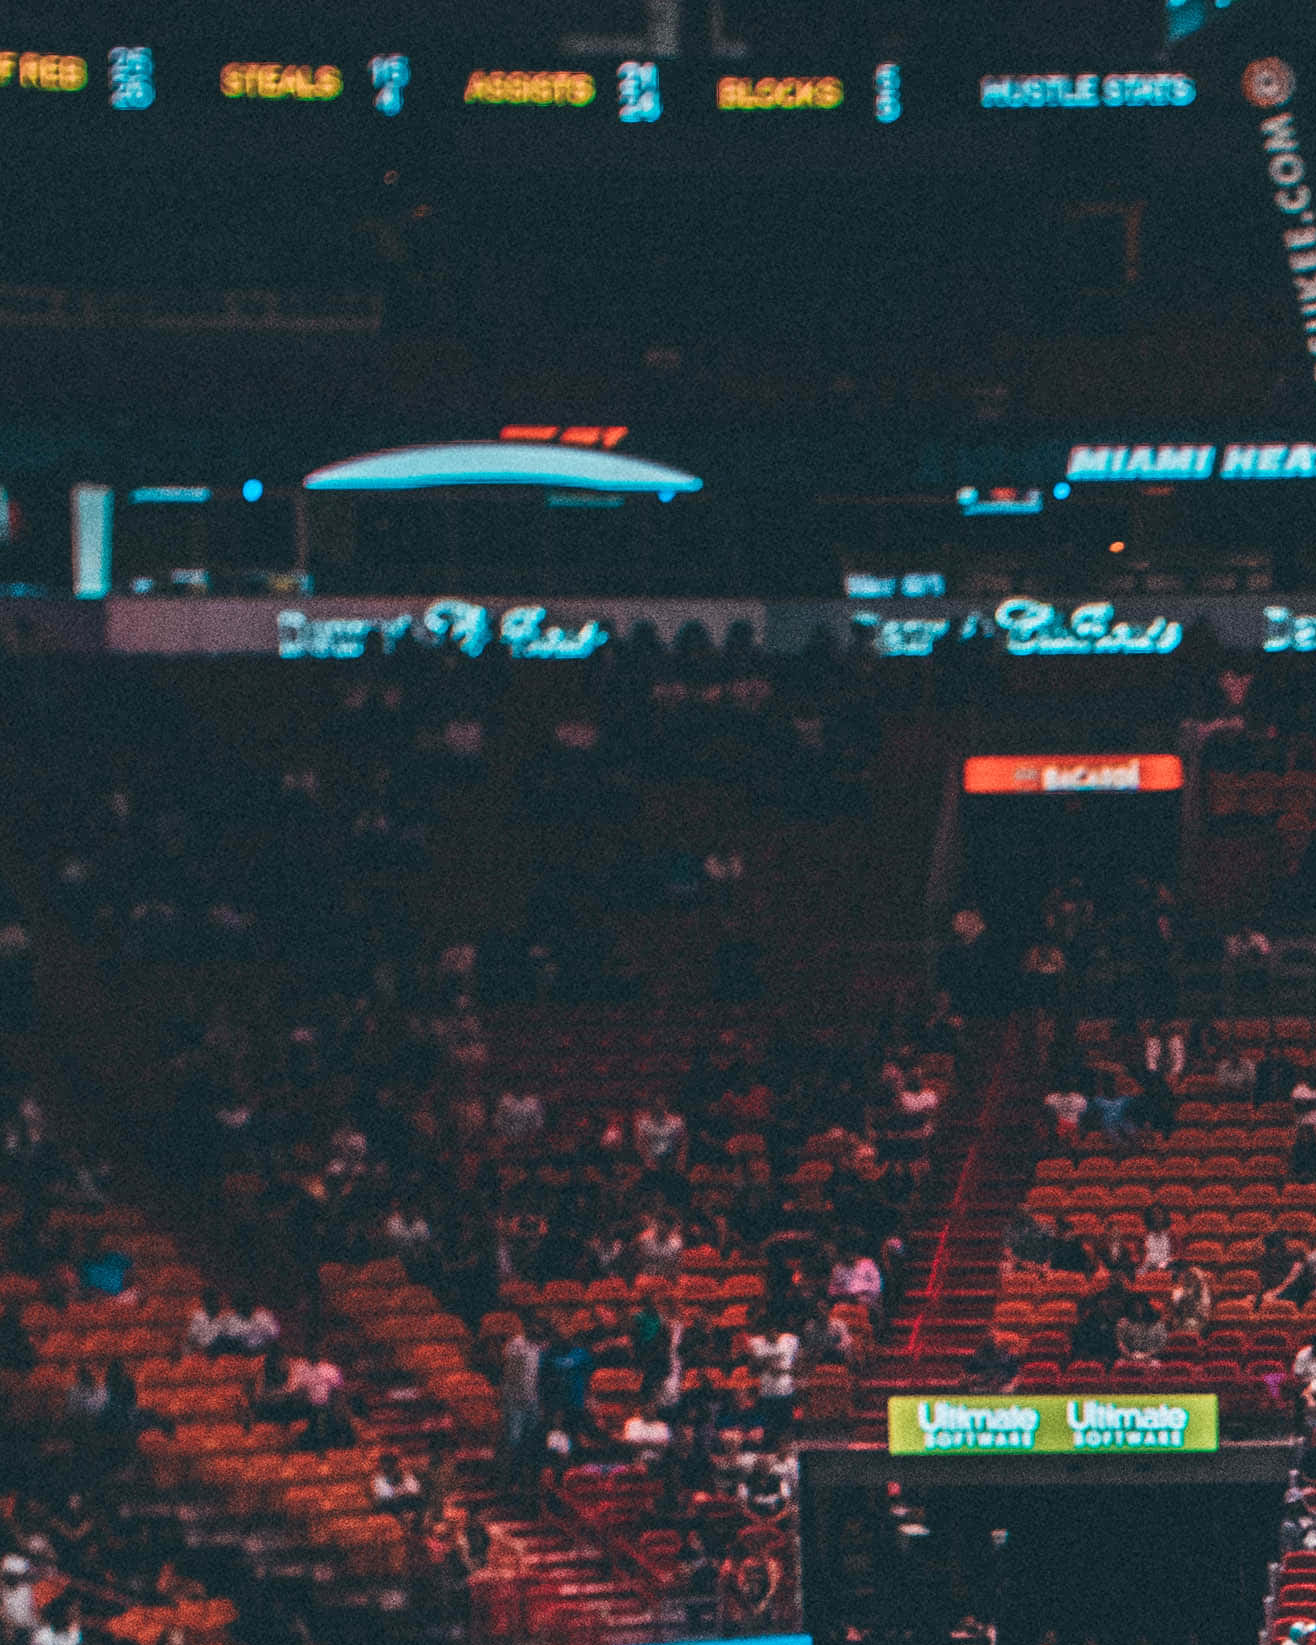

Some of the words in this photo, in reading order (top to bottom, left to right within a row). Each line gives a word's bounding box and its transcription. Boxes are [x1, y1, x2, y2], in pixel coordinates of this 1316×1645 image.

[219, 61, 344, 100] STEALS
[463, 70, 597, 107] ASSISTS
[717, 76, 844, 110] BLOCKS
[1066, 442, 1216, 481] MIAMI
[918, 1400, 1041, 1432] Ultimate
[1066, 1399, 1190, 1431] Ultimate
